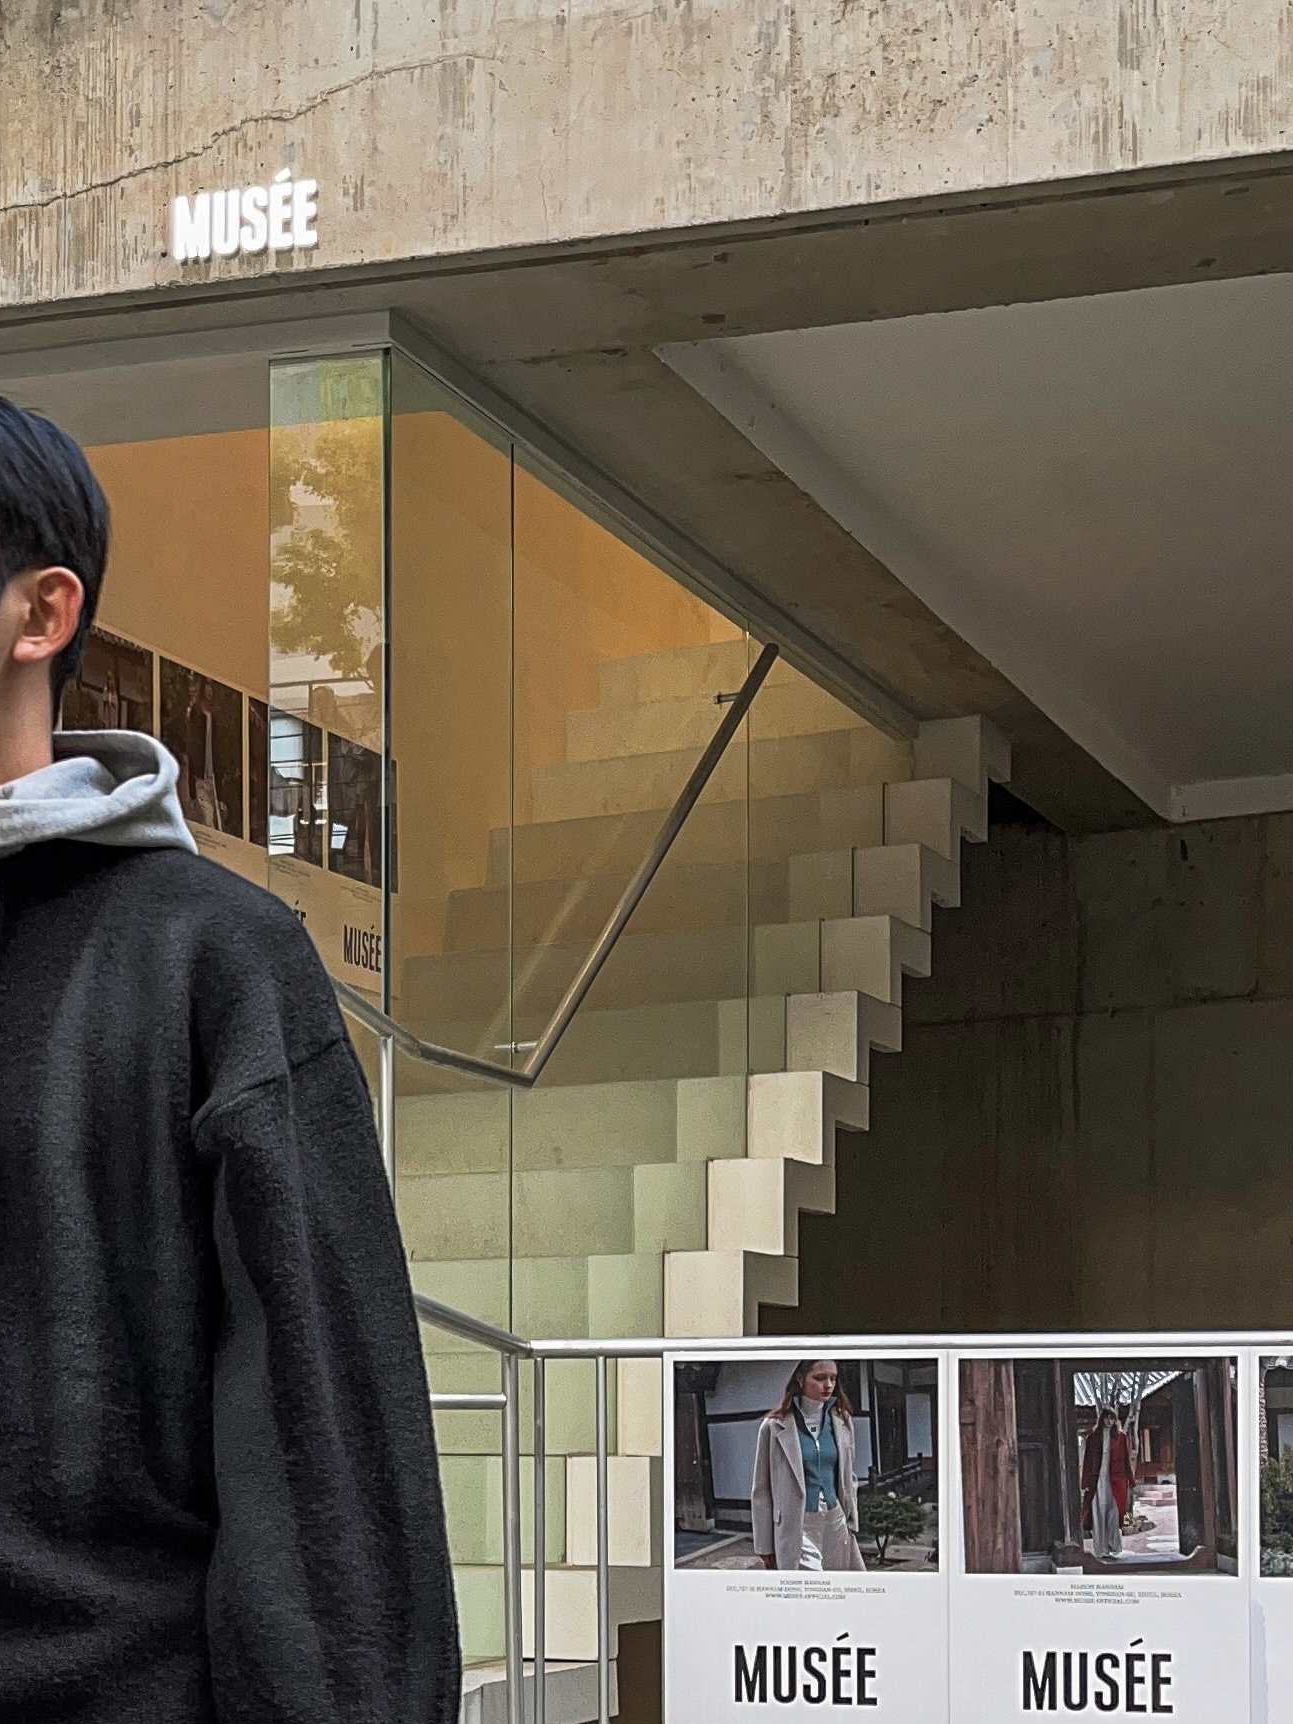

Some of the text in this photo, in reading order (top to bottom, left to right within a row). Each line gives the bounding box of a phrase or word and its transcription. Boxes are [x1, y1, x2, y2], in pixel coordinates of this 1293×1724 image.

[174, 167, 318, 260] MUSÉE
[734, 1632, 878, 1706] MUSÉE
[1022, 1638, 1174, 1713] MUSÉE
